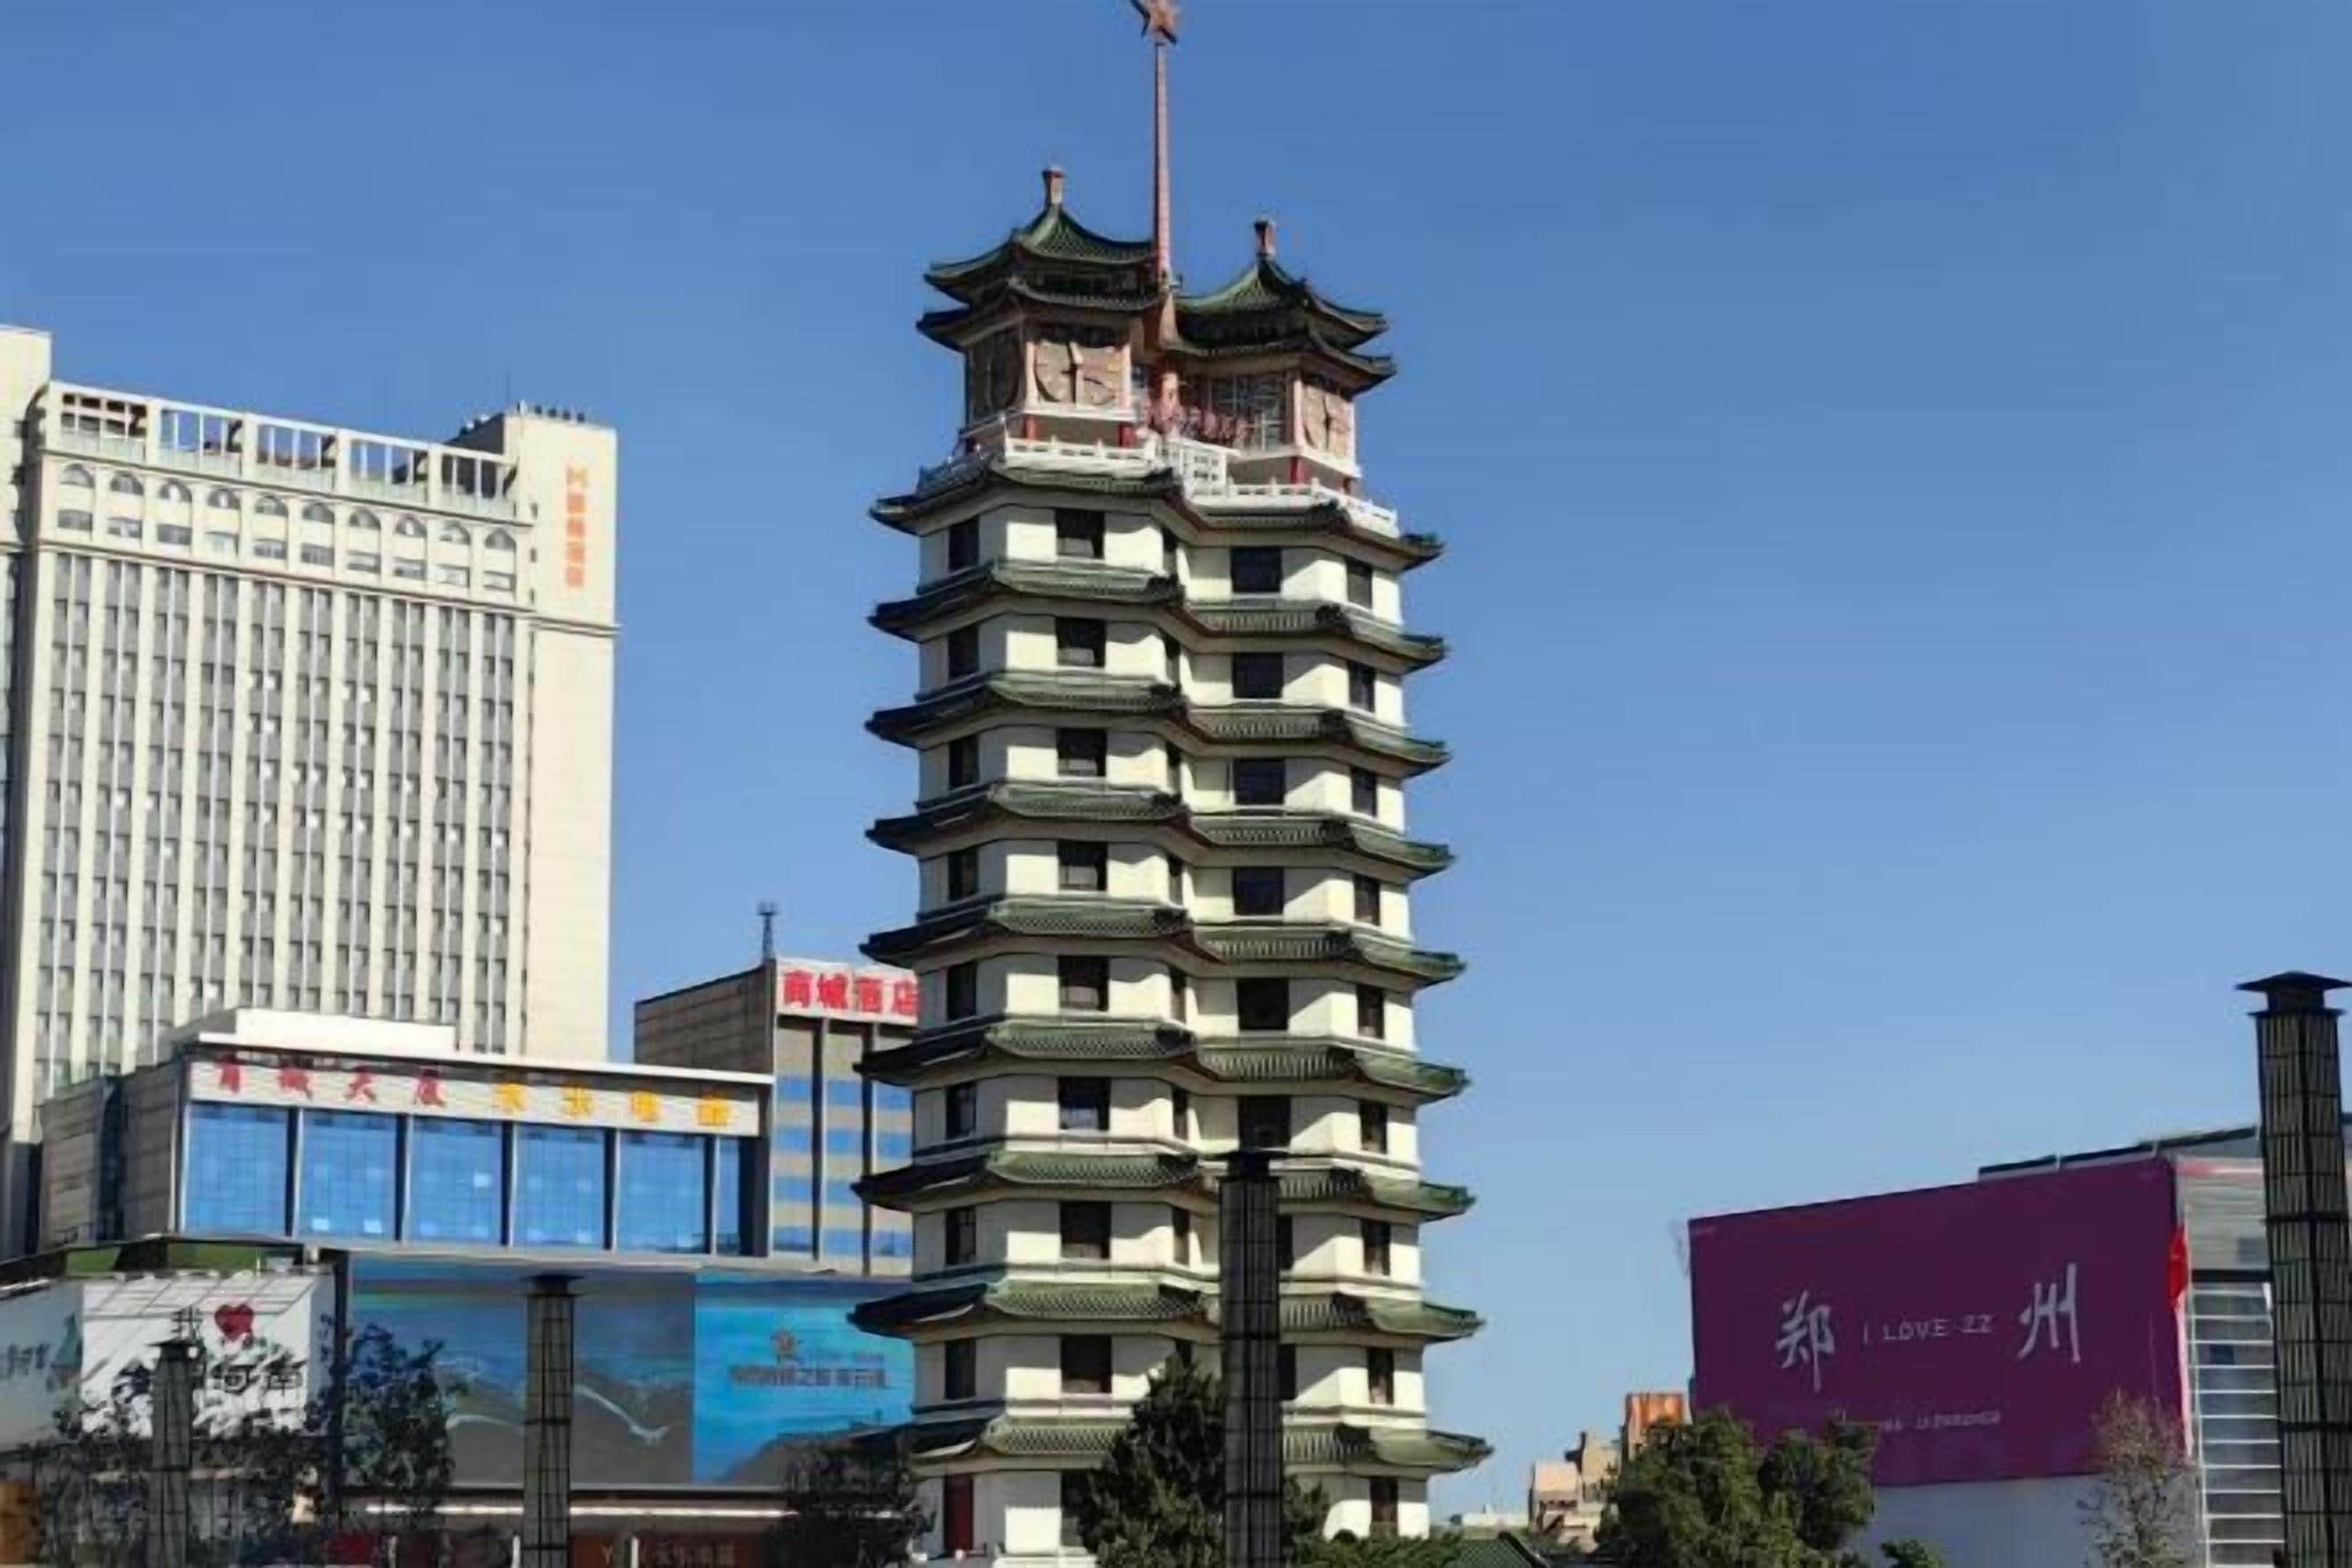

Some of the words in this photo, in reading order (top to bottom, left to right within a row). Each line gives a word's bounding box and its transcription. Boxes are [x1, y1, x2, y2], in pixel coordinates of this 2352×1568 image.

[1776, 1290, 1835, 1393] 郑
[1882, 1319, 1949, 1341] LOVE
[2016, 1262, 2081, 1363] 州
